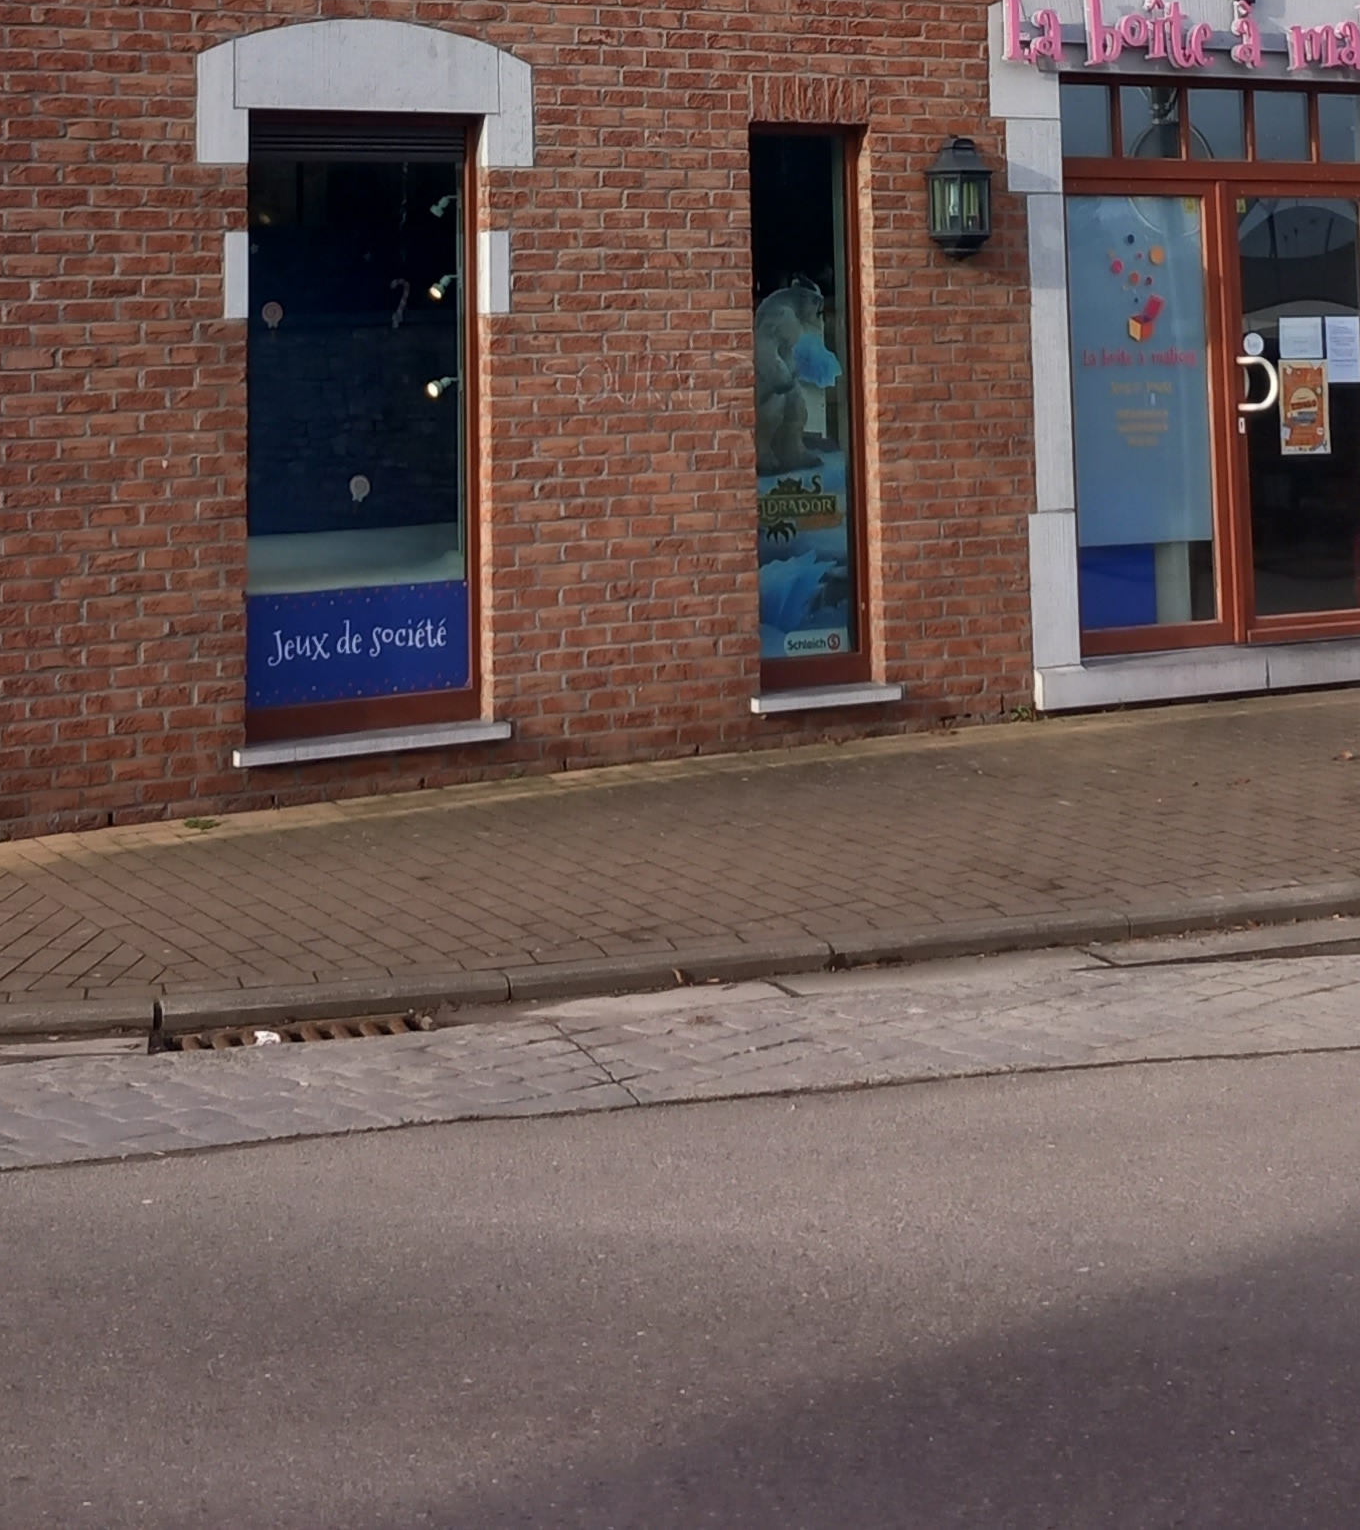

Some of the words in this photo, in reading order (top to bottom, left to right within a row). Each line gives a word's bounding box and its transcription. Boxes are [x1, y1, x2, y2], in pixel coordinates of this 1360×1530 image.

[1230, 0, 1263, 69] à
[758, 498, 835, 519] LDRADOR
[267, 630, 330, 666] Jeux
[336, 620, 362, 654] de
[369, 618, 447, 657] société
[787, 638, 827, 651] Schleich
